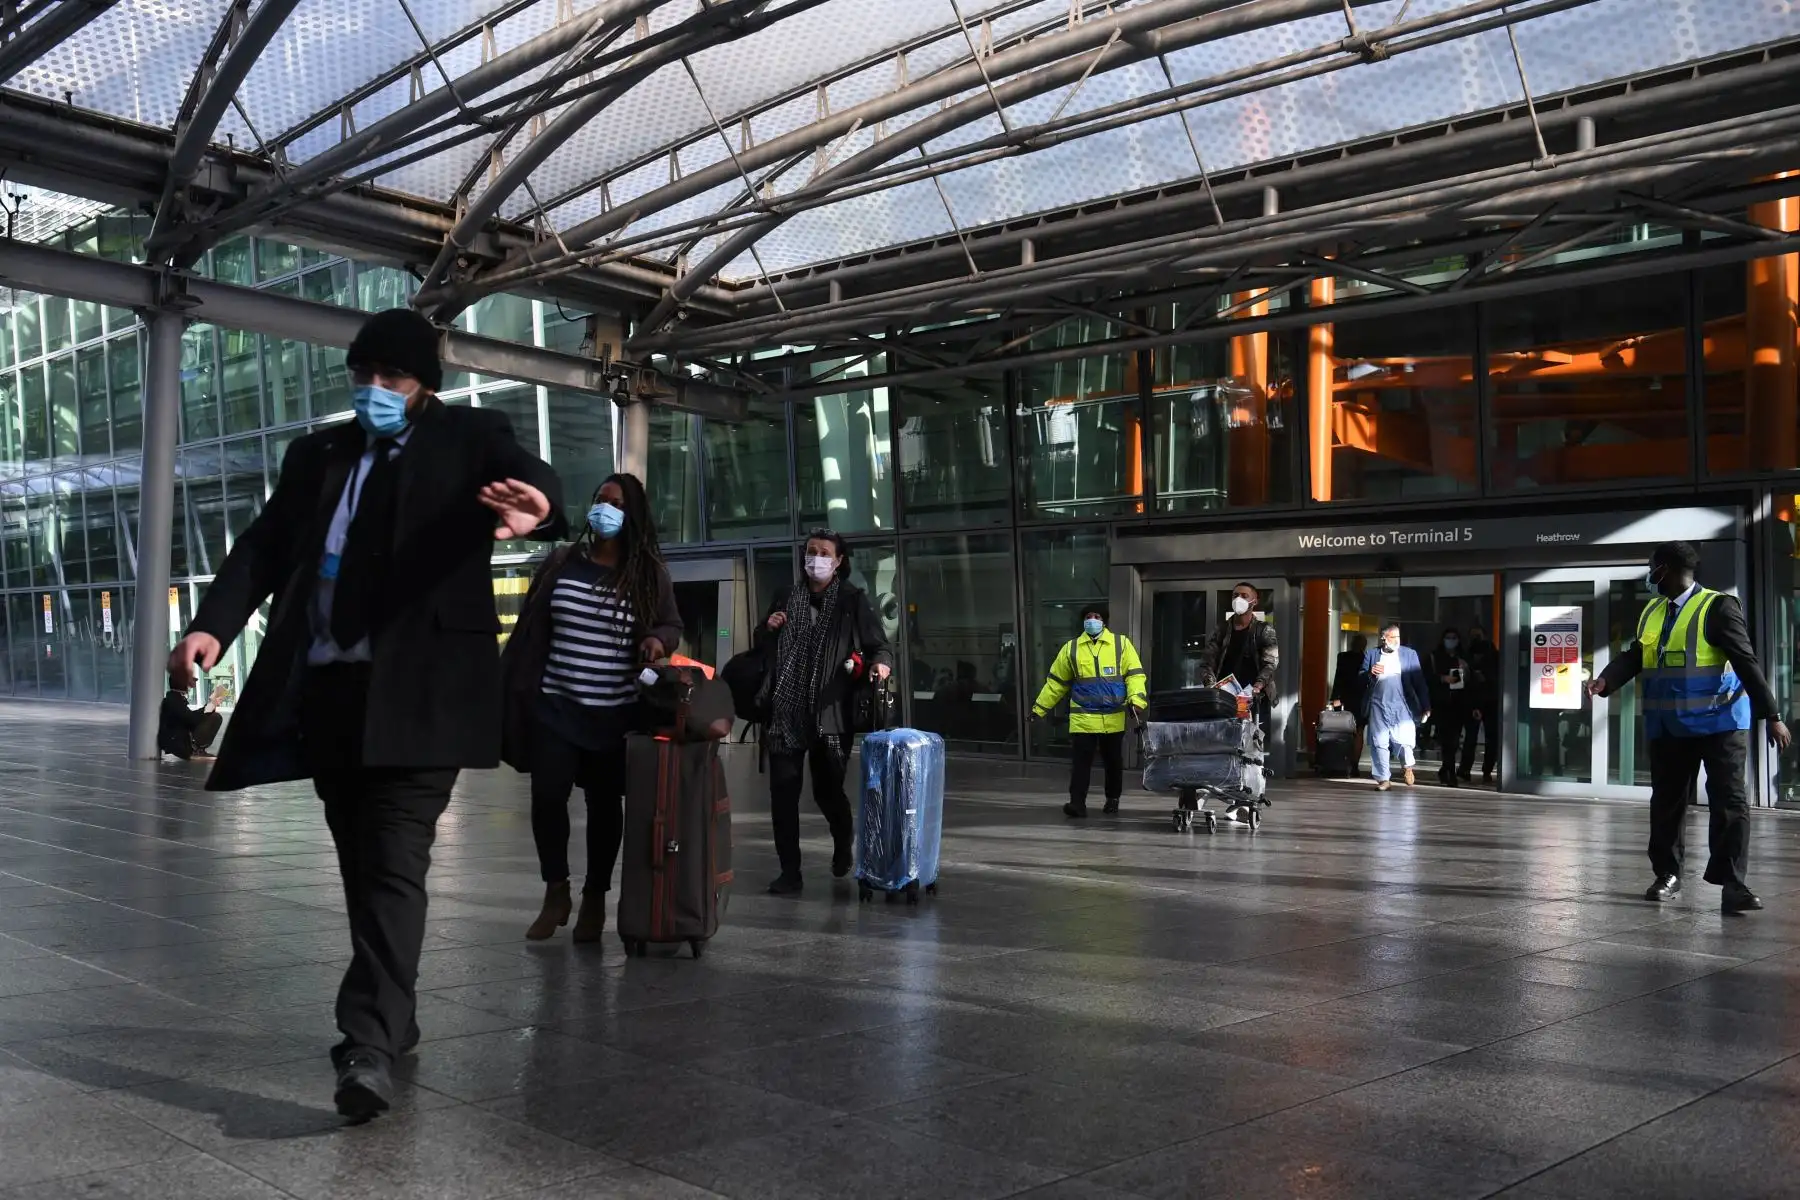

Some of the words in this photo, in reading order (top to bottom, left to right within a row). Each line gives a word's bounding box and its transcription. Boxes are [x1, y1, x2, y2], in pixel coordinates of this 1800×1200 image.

[1298, 534, 1366, 548] Welcome
[1370, 533, 1386, 545] to
[1389, 528, 1459, 544] Terminal
[1463, 527, 1473, 541] 5
[1536, 532, 1580, 542] Heathrow
